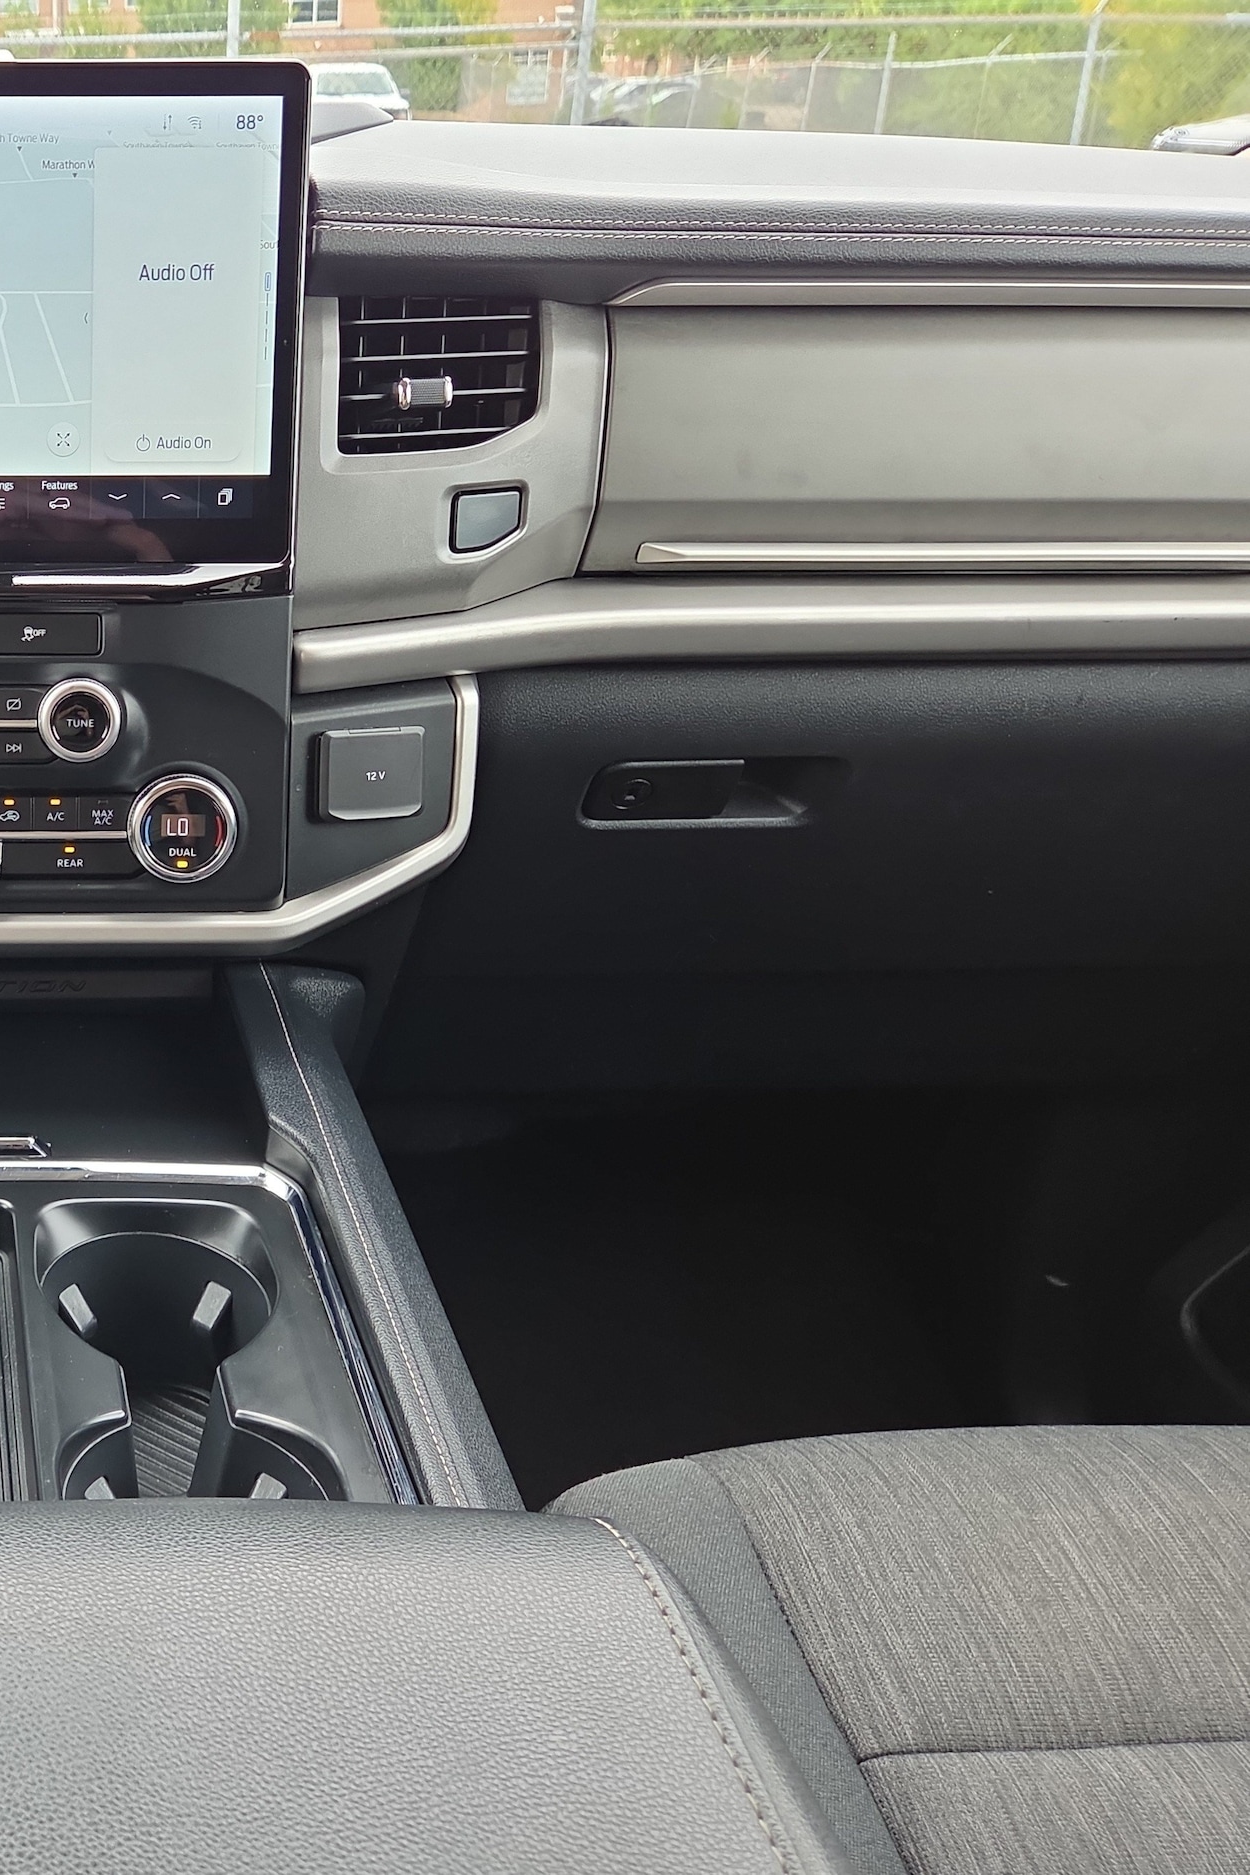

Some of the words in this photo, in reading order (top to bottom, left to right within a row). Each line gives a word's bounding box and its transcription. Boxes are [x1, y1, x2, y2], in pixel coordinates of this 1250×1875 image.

[8, 133, 38, 143] Towne
[40, 133, 59, 144] Way
[42, 160, 86, 170] Marathon
[139, 264, 185, 281] Audio
[189, 264, 215, 281] Off
[156, 437, 192, 449] Audio
[194, 437, 212, 449] On
[41, 480, 78, 491] Features
[33, 628, 46, 637] OFF
[66, 718, 95, 729] TUNE
[366, 772, 377, 781] 12
[378, 771, 386, 780] V
[46, 812, 65, 822] A/C
[92, 809, 114, 818] MAX
[94, 817, 112, 826] A/C
[168, 848, 197, 857] DUAL
[57, 859, 84, 868] REAR
